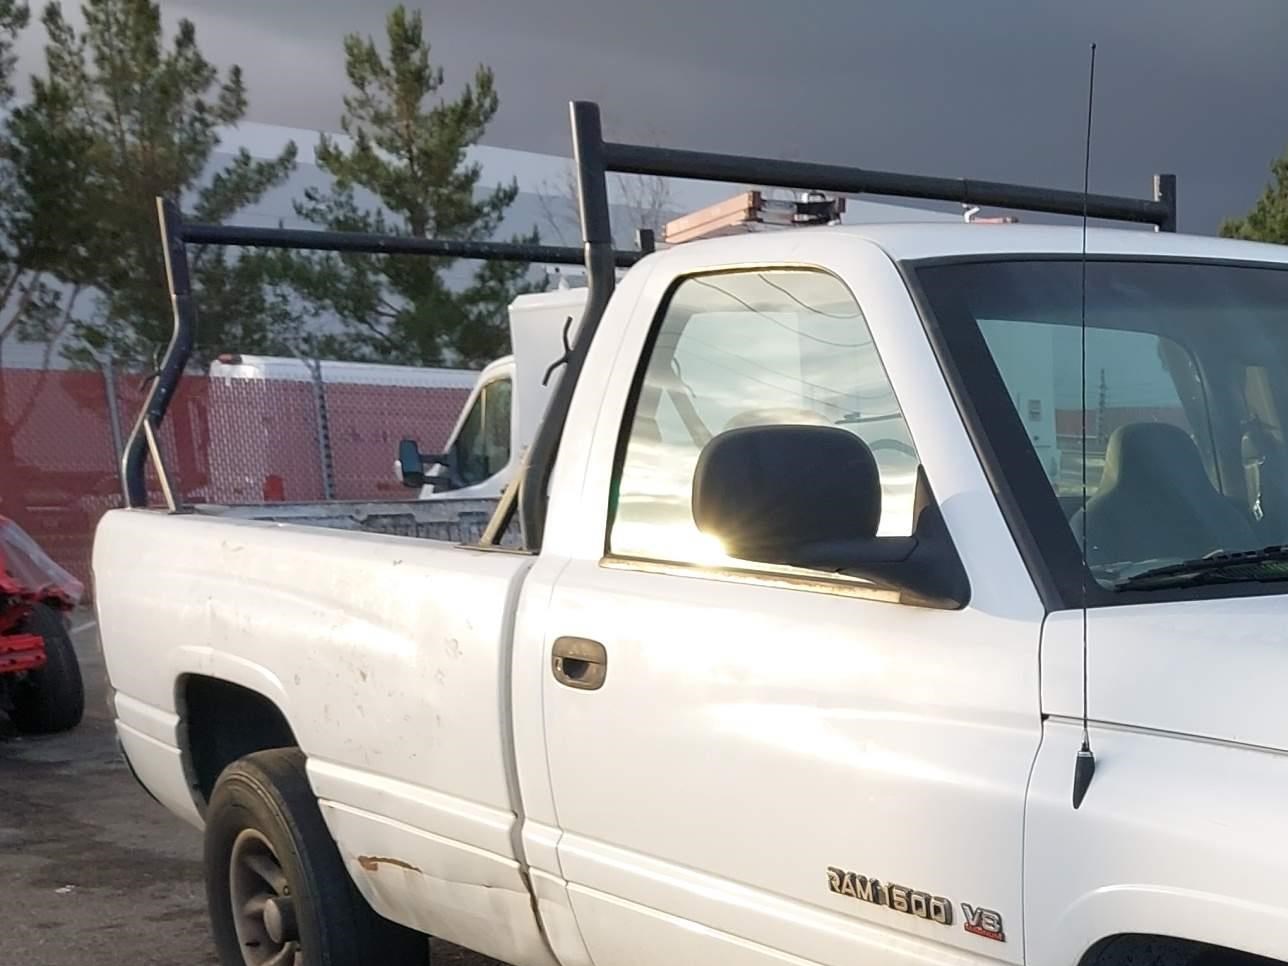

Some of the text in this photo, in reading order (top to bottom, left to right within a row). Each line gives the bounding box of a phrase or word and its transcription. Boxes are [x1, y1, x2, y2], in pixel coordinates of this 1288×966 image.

[827, 867, 880, 903] RAM
[878, 883, 952, 925] 1500
[961, 903, 1003, 933] V8
